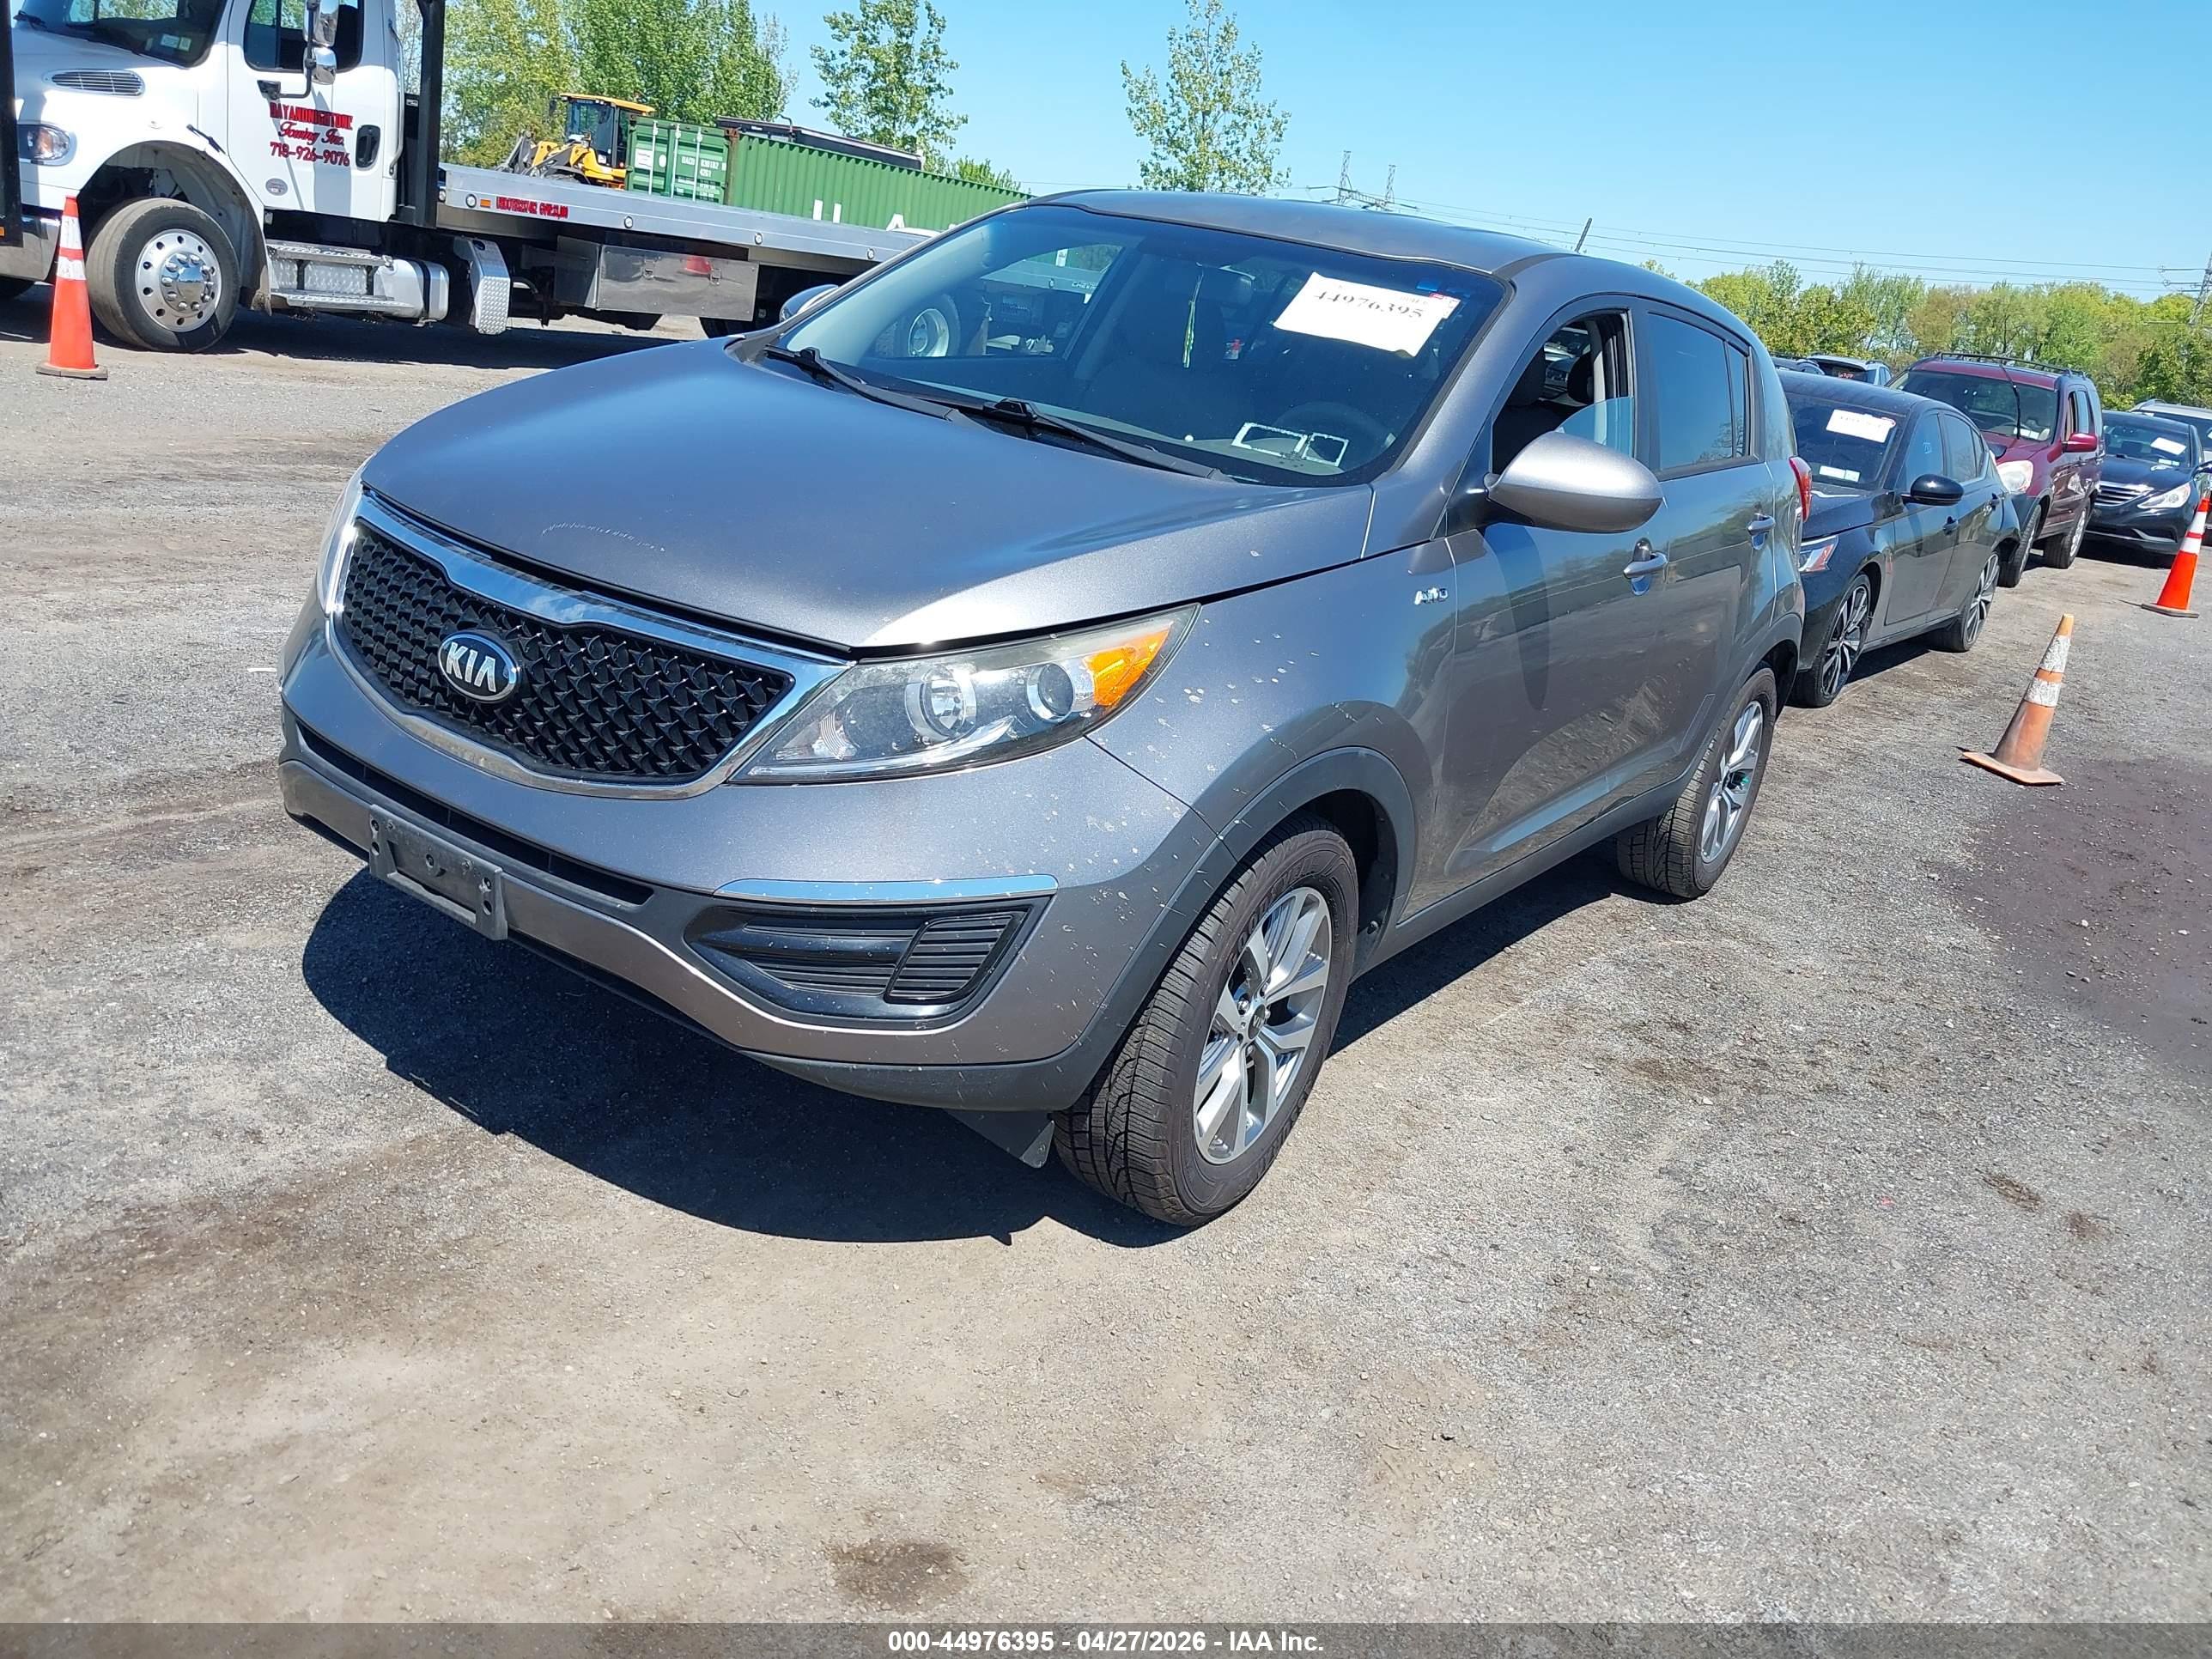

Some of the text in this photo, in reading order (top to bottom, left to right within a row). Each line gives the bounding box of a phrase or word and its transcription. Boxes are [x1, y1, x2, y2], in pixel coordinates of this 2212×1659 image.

[278, 121, 320, 145] Towing
[270, 142, 350, 167] 718-926-9076
[446, 641, 496, 694] KIA
